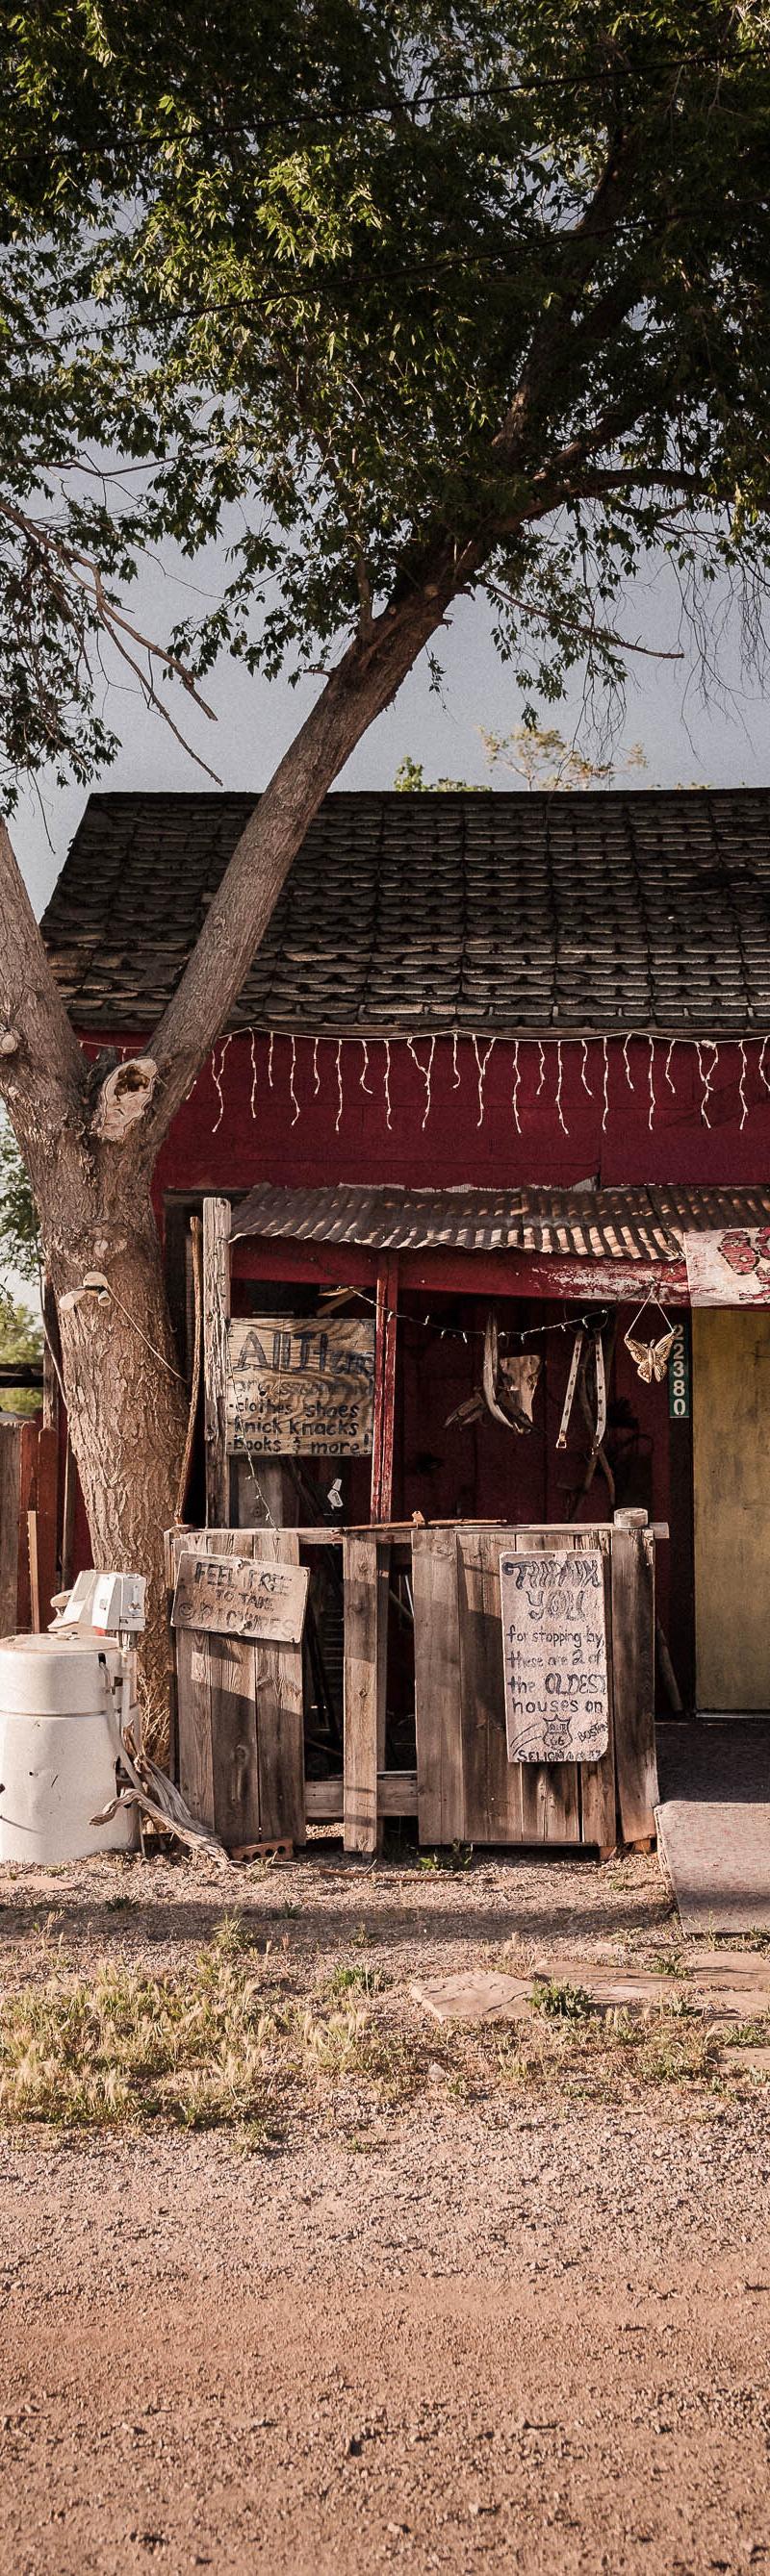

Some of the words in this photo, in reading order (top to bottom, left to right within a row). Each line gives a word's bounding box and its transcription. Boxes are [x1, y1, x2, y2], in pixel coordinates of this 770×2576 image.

[673, 1324, 686, 1416] 22380
[305, 1401, 360, 1419] shoes
[289, 1417, 359, 1436] knacks
[311, 1434, 370, 1454] more!
[194, 1561, 237, 1589] FEEL
[215, 1589, 234, 1602] TO
[238, 1592, 274, 1612] TAKE
[526, 1589, 585, 1623] YOU
[506, 1624, 526, 1643] for
[531, 1626, 582, 1648] stopping
[506, 1651, 544, 1668] these
[548, 1656, 568, 1666] are
[572, 1649, 585, 1665] 2
[588, 1649, 603, 1665] of
[507, 1676, 536, 1694] the
[544, 1673, 606, 1695] OLDEST
[511, 1698, 578, 1714] houses
[585, 1700, 603, 1713] on
